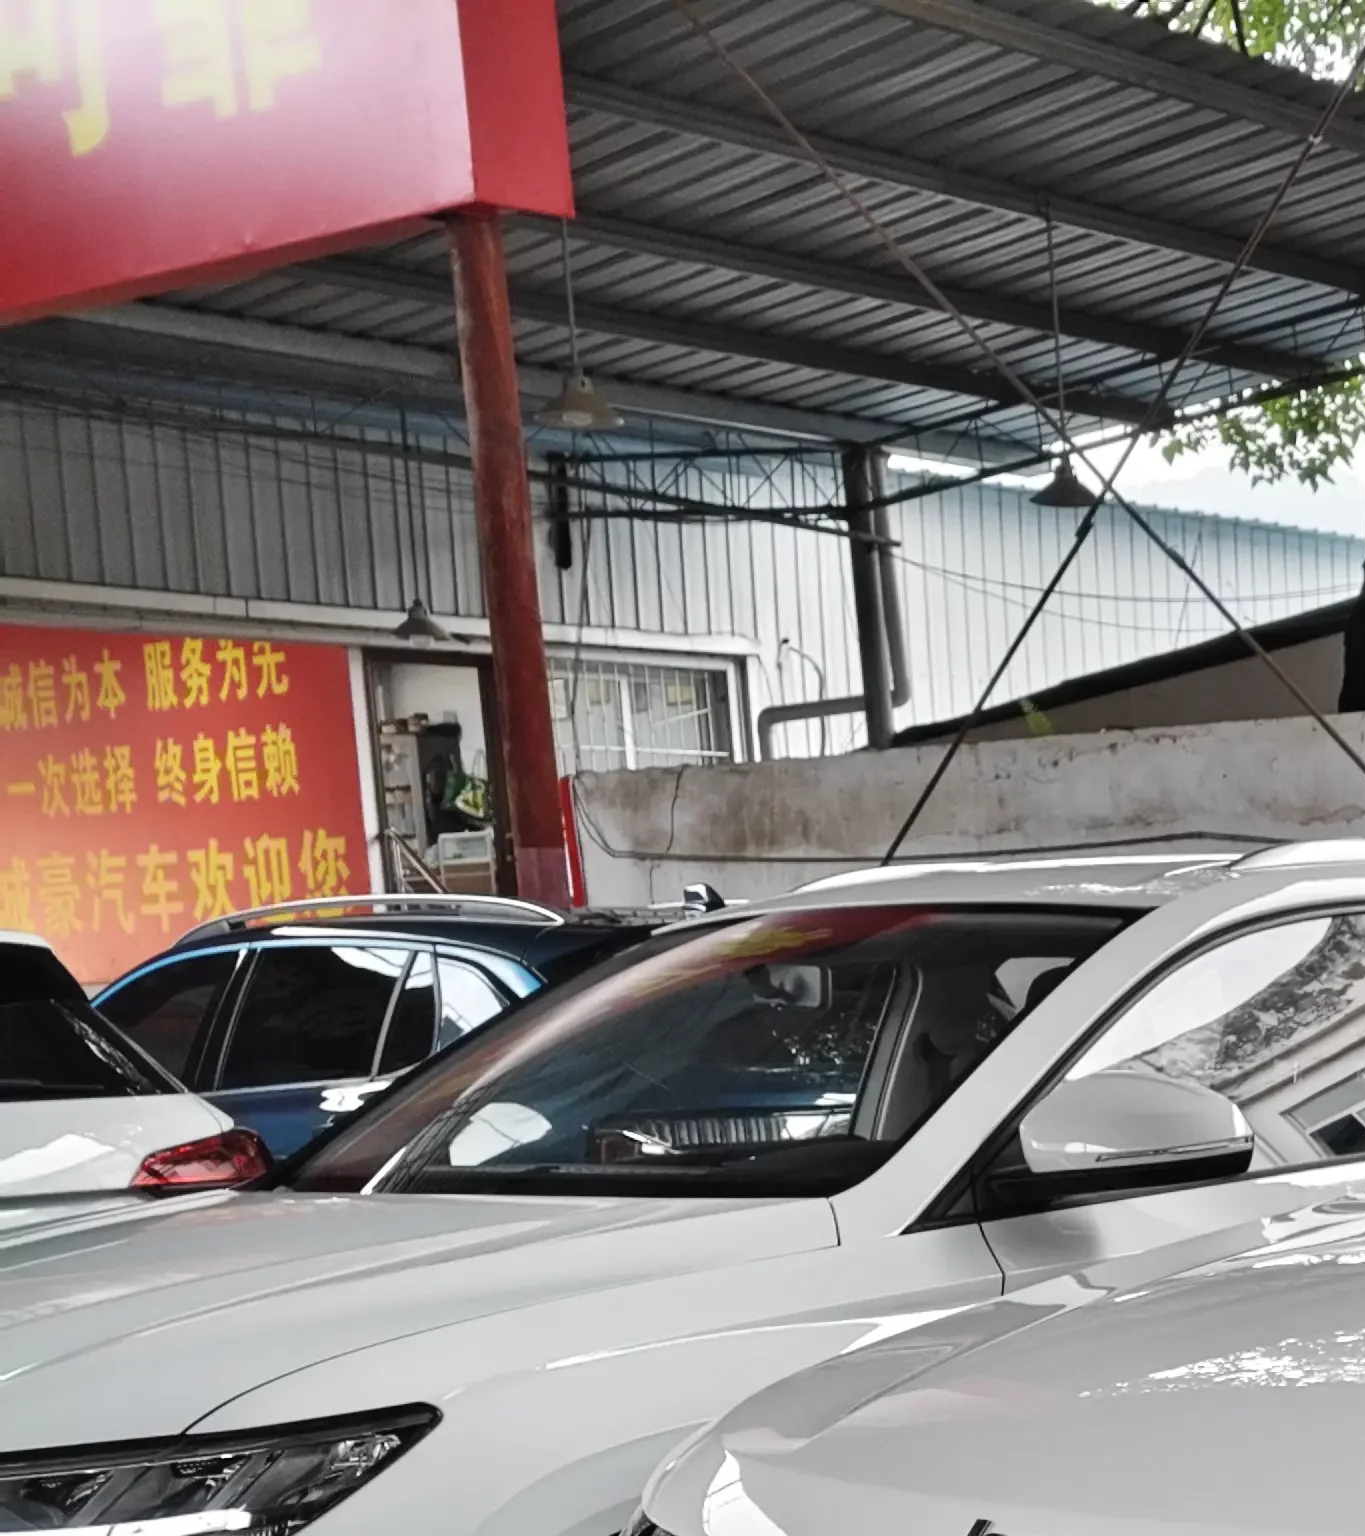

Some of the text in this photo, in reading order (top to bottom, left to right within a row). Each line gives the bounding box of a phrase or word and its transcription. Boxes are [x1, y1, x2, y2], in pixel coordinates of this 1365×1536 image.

[143, 637, 289, 711] 服务为先
[7, 722, 300, 818] 一次选择 终身信赖
